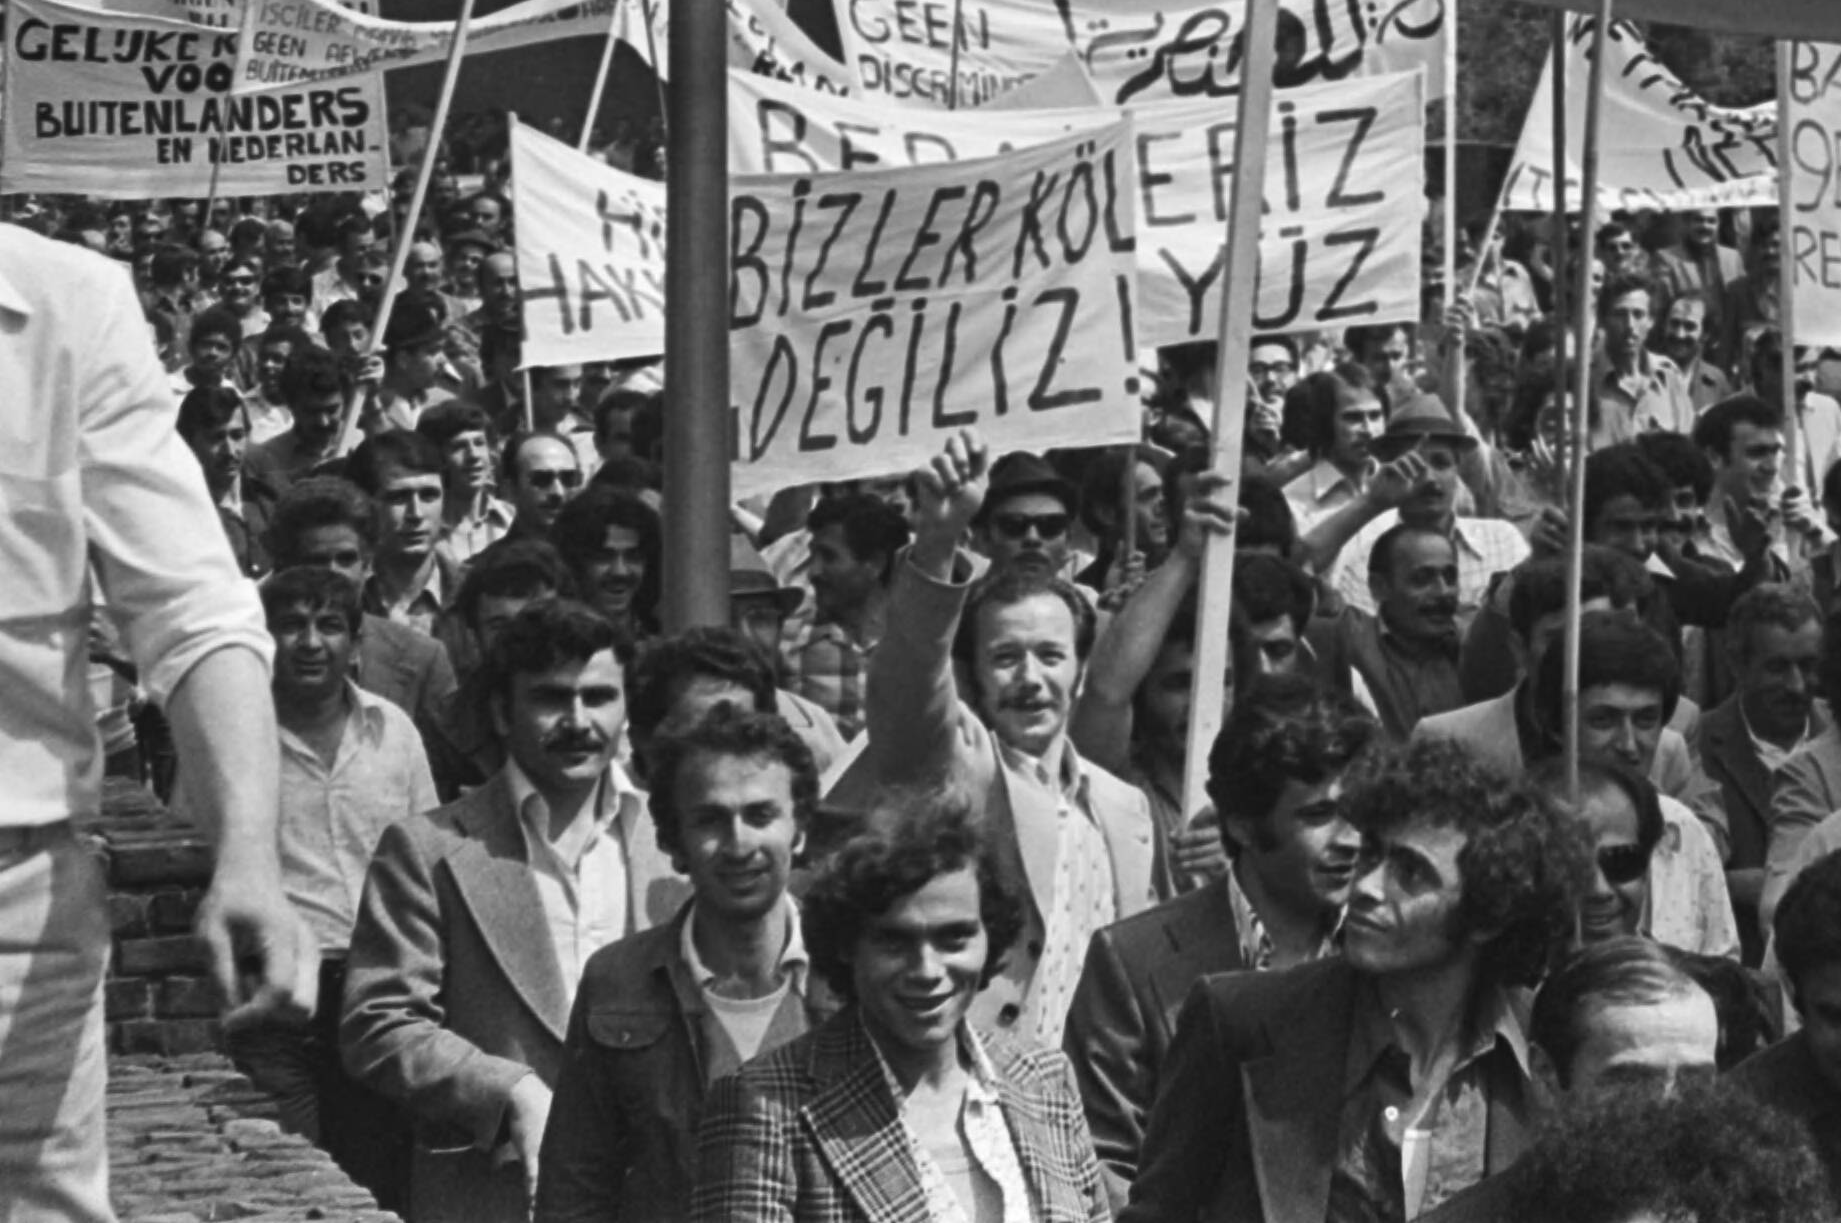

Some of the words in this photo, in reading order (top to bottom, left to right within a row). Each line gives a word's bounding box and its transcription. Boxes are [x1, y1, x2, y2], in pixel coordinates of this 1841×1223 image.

[253, 30, 307, 58] GEEN
[35, 87, 370, 139] BUITENLANDERS
[156, 137, 192, 164] EN
[286, 161, 367, 185] DERS
[731, 179, 1000, 331] BİZLER
